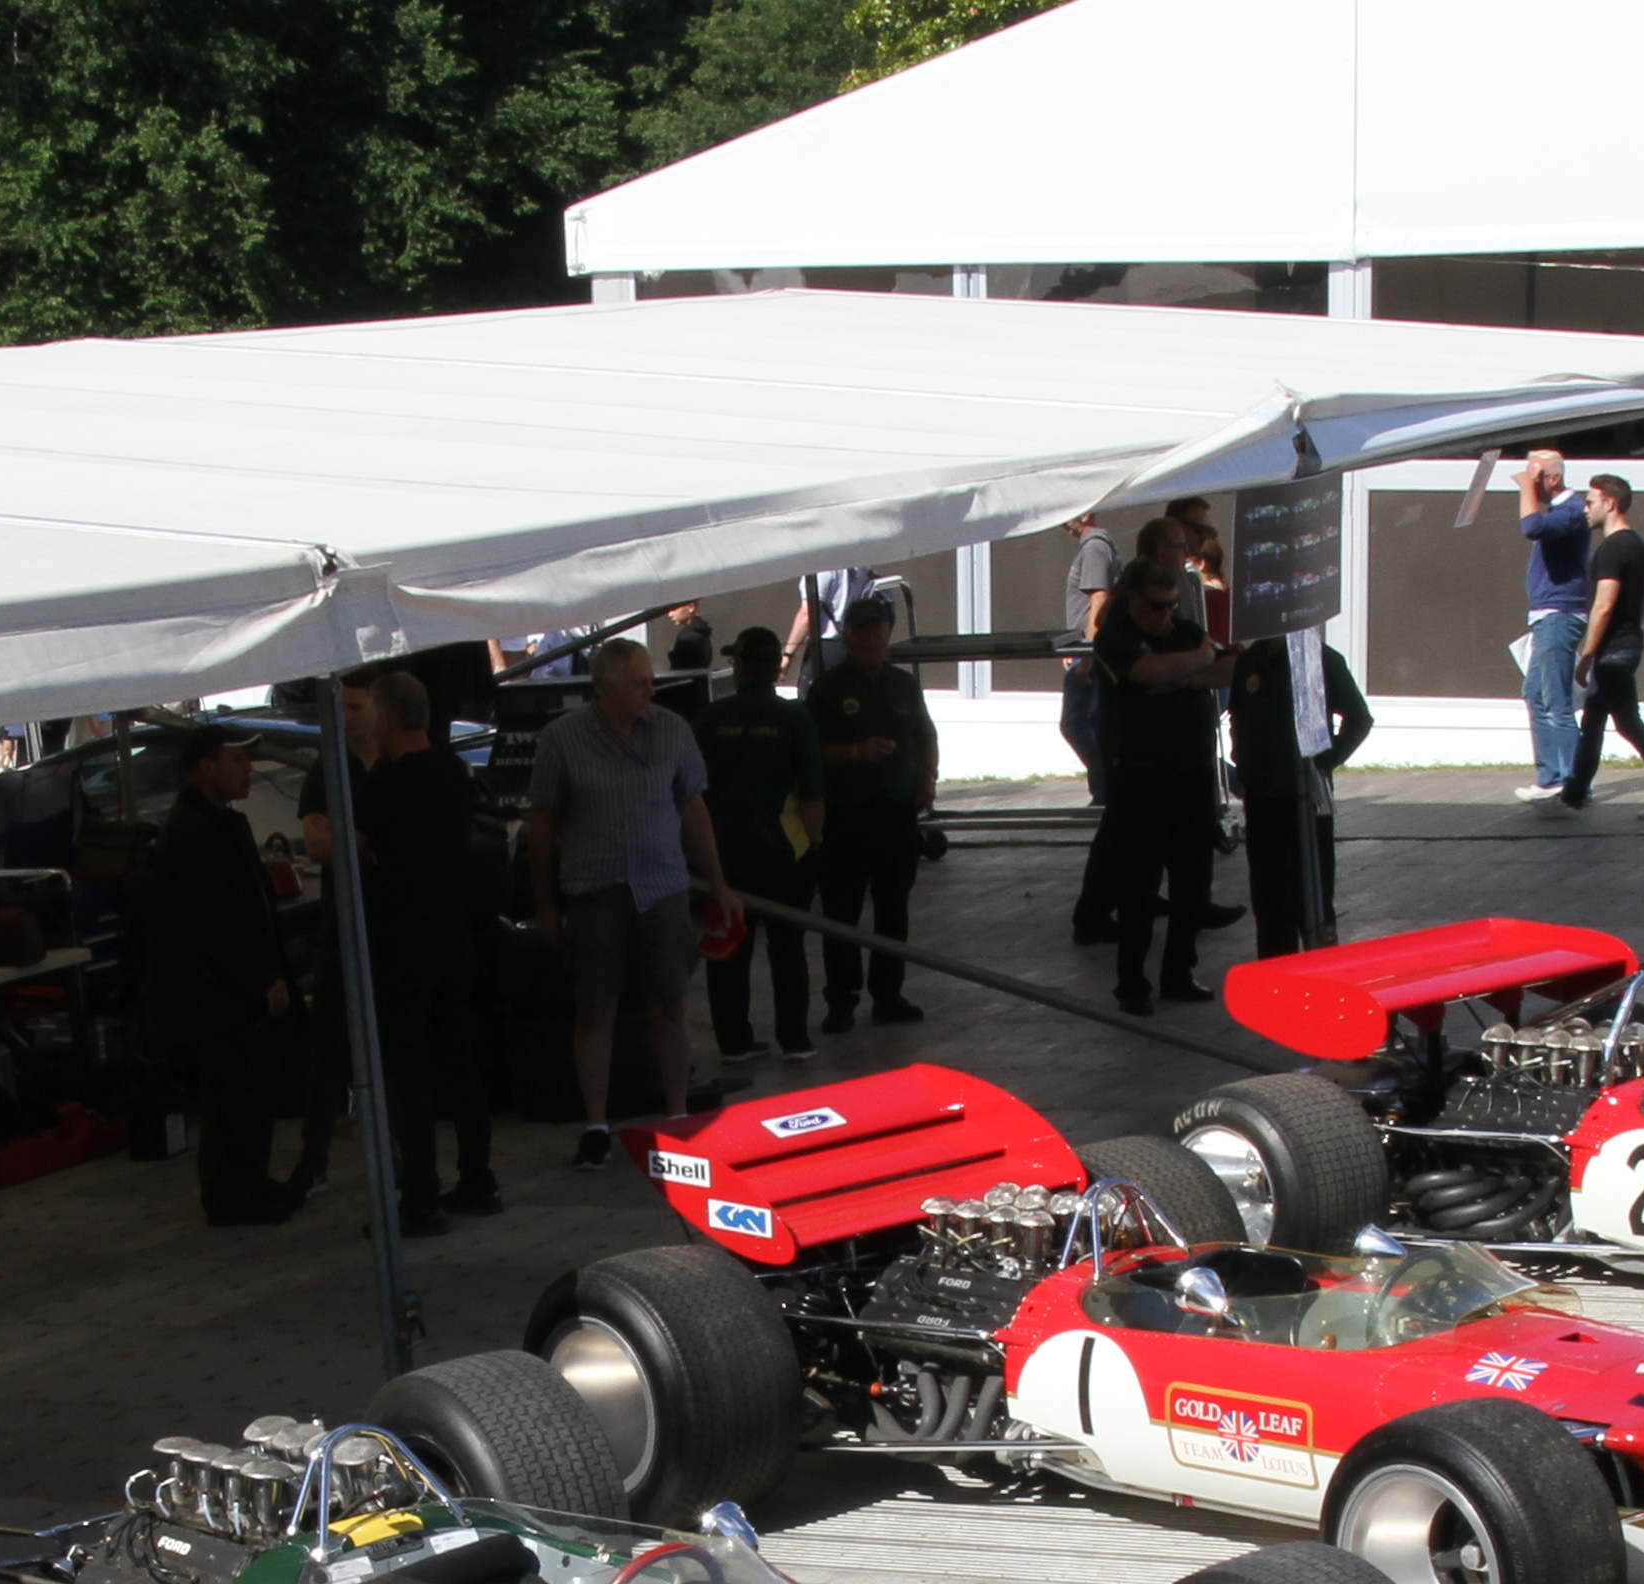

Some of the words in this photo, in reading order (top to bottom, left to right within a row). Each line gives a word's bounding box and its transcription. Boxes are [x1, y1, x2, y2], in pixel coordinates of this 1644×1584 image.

[787, 1115, 822, 1130] Ford
[1173, 1100, 1223, 1135] AVON
[651, 1155, 706, 1181] Shell
[937, 1276, 972, 1290] FORD
[916, 1314, 951, 1328] FORD
[1077, 1336, 1096, 1436] 1
[1174, 1398, 1222, 1422] GOLD
[1258, 1412, 1303, 1437] LEAF
[1179, 1440, 1226, 1462] TEAM
[1261, 1455, 1308, 1478] LOTUS
[157, 1535, 192, 1556] FORD
